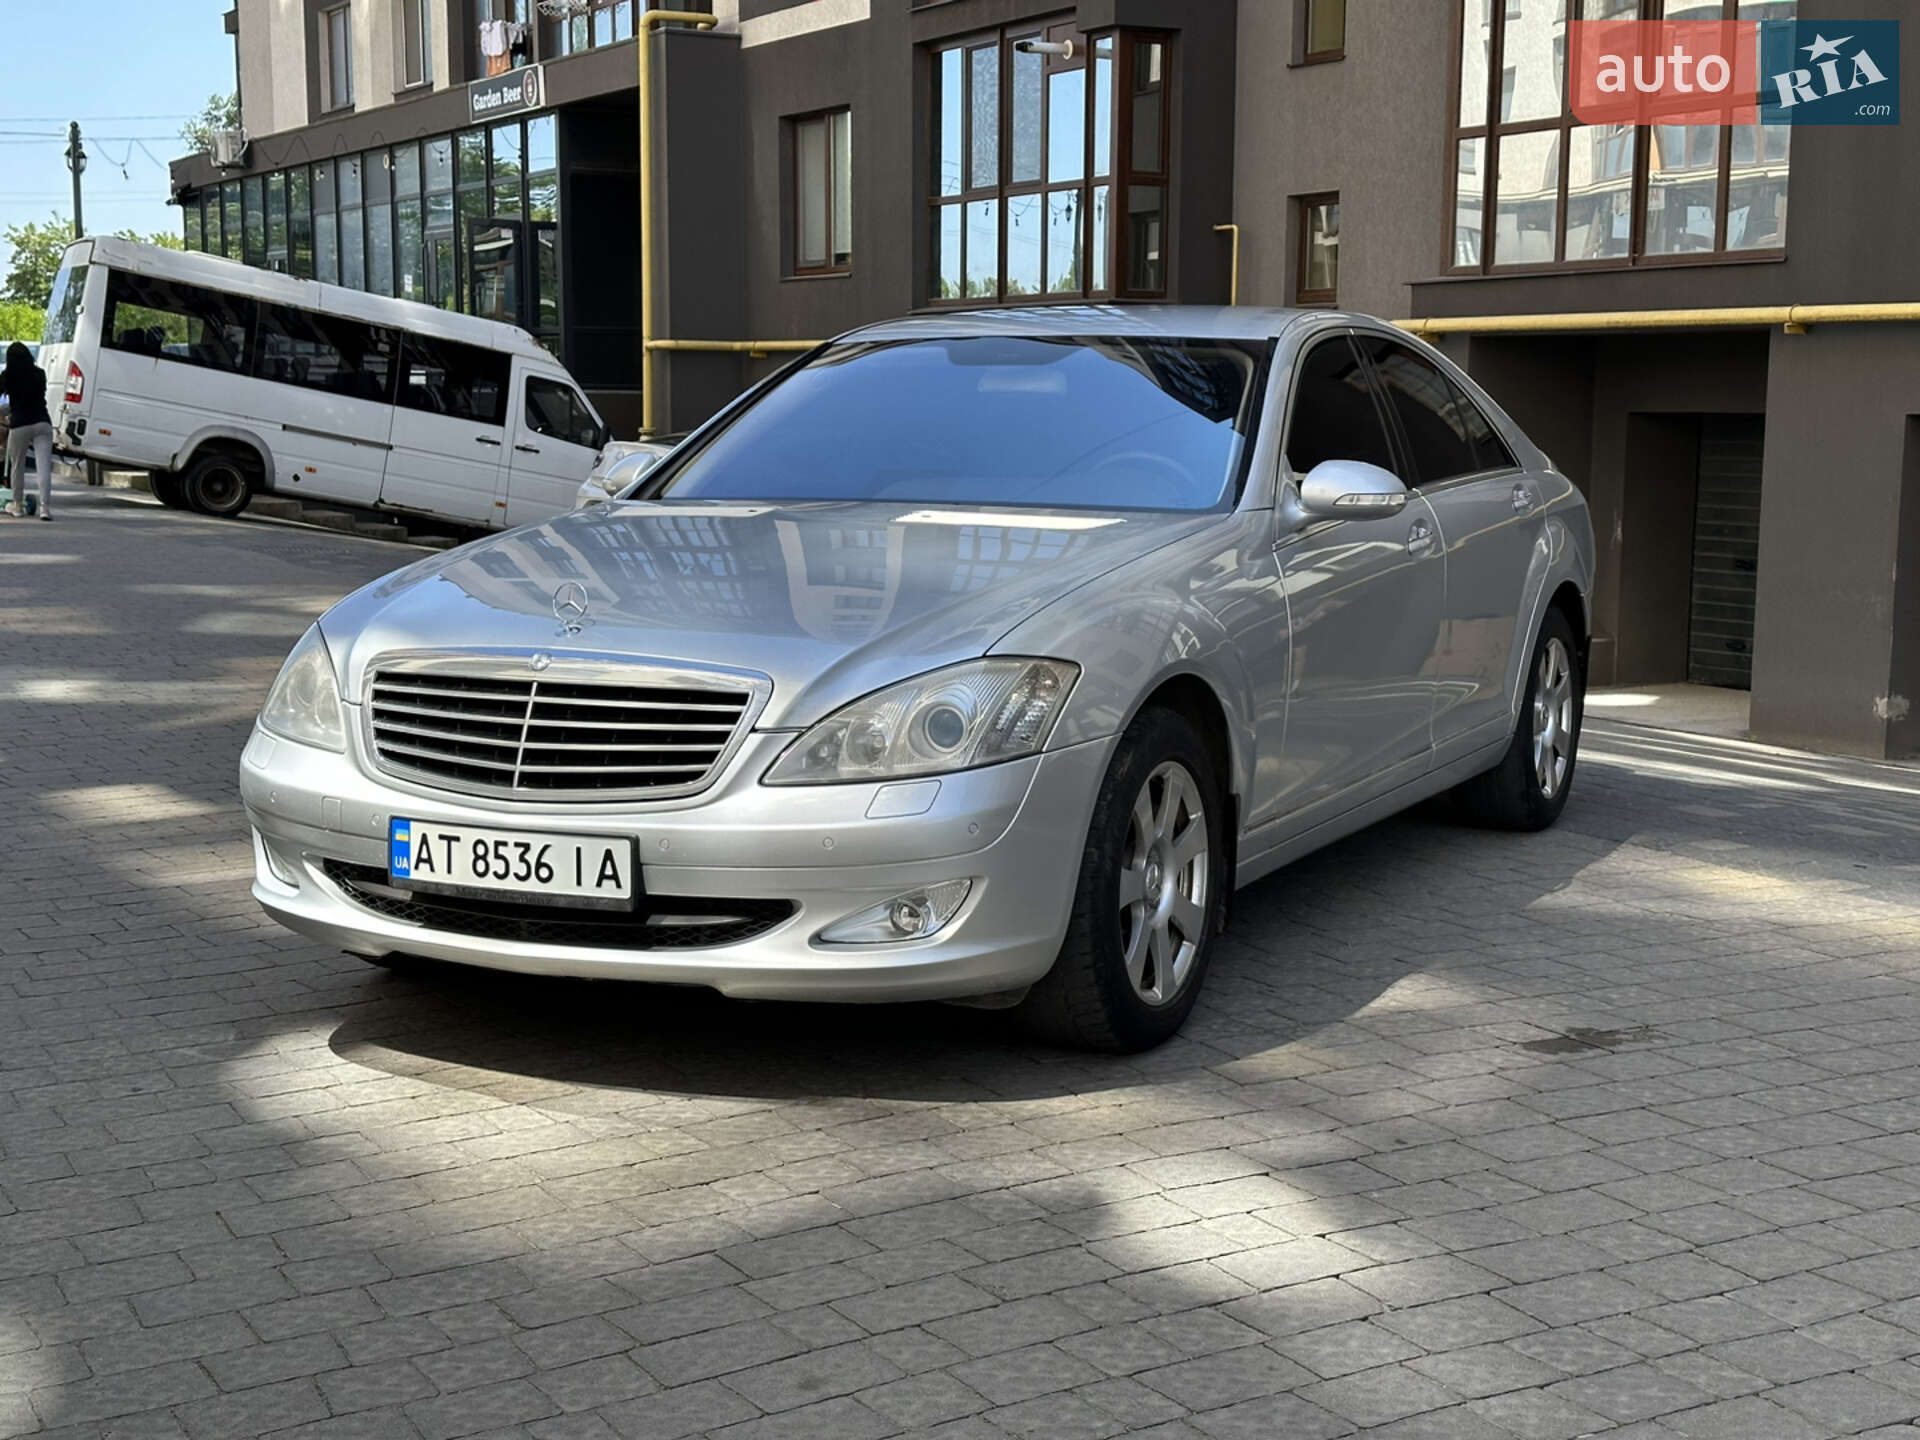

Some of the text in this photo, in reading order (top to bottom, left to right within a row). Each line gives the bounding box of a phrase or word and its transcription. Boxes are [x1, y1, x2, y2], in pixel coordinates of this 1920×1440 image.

[473, 88, 502, 111] Garden
[503, 86, 522, 104] Beer
[395, 856, 409, 870] UA
[414, 832, 622, 889] AT 8536 IA
